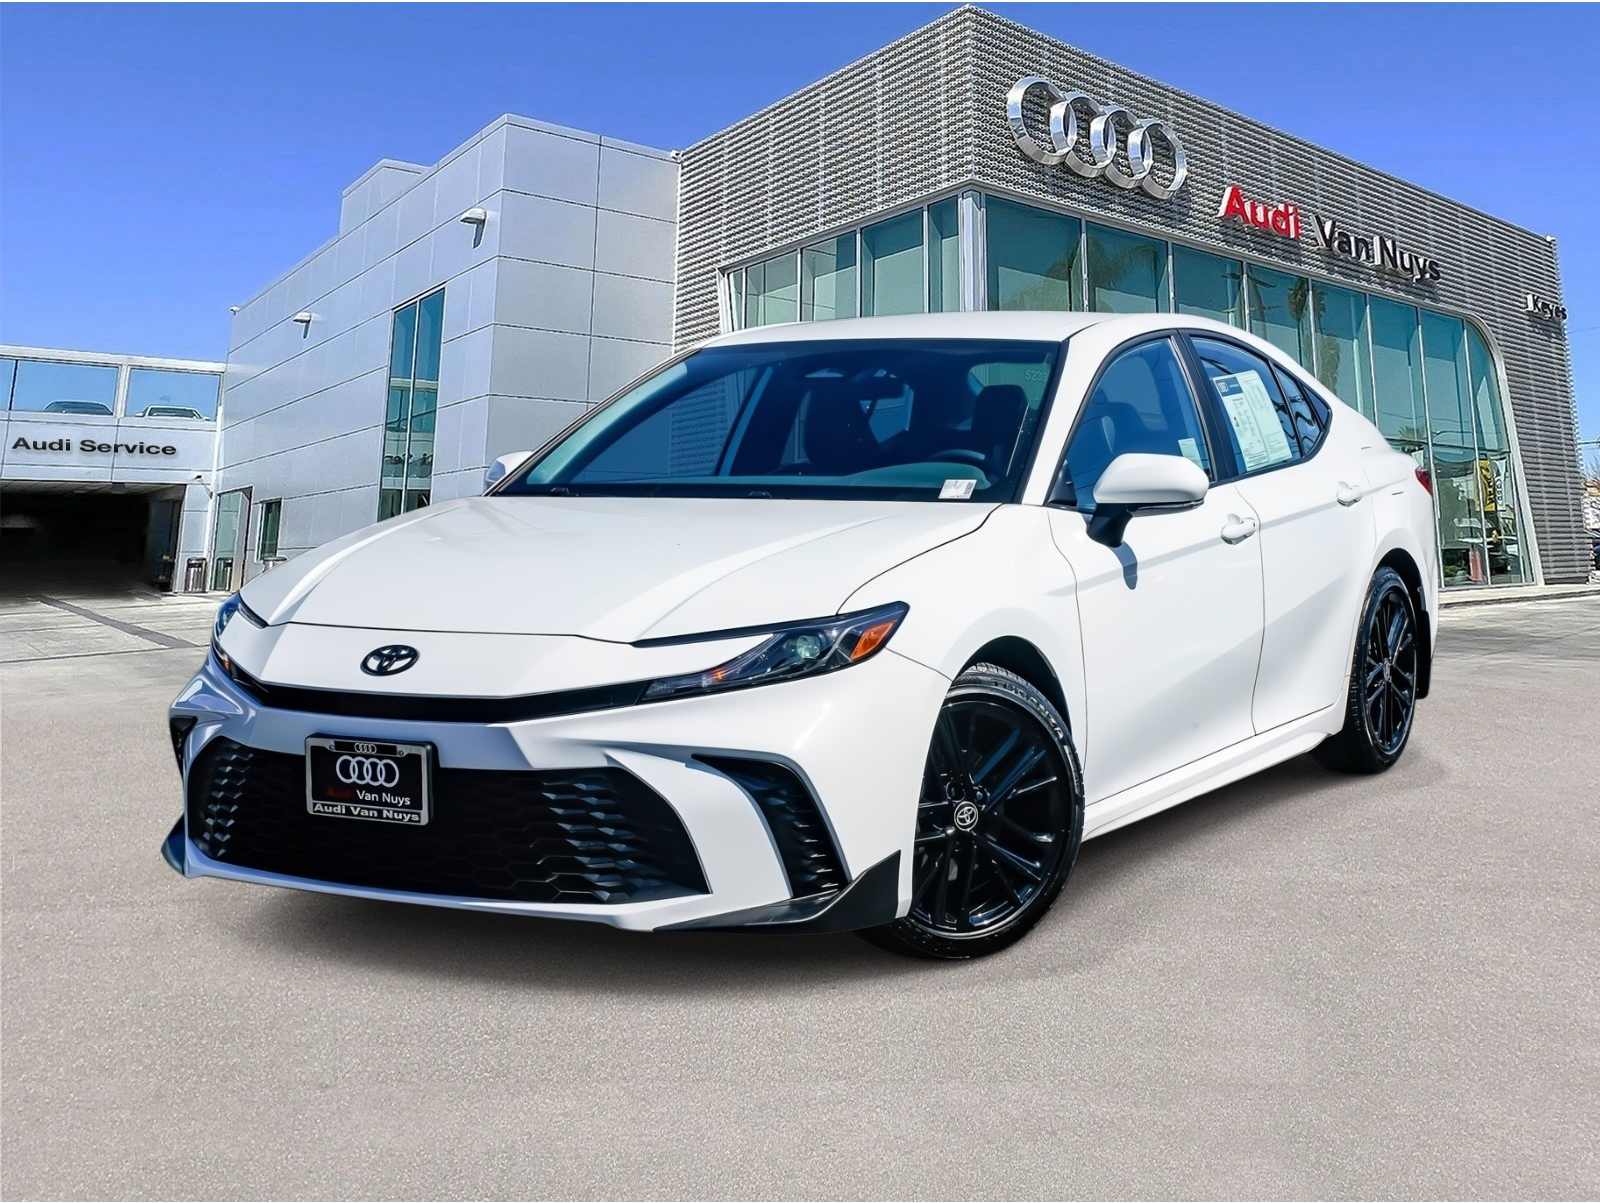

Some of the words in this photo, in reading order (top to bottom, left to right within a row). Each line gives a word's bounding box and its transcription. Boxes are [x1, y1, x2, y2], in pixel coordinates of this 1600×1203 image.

[1217, 184, 1301, 240] Audi
[1311, 214, 1373, 263] Van
[1374, 236, 1442, 283] Nuys
[1526, 293, 1568, 321] Keyes
[12, 437, 71, 451] Audi
[79, 439, 177, 455] Service
[356, 789, 379, 802] Van
[382, 792, 411, 807] Nuys
[313, 802, 346, 814] Audi
[350, 806, 378, 817] Van
[382, 809, 420, 822] Nuys
